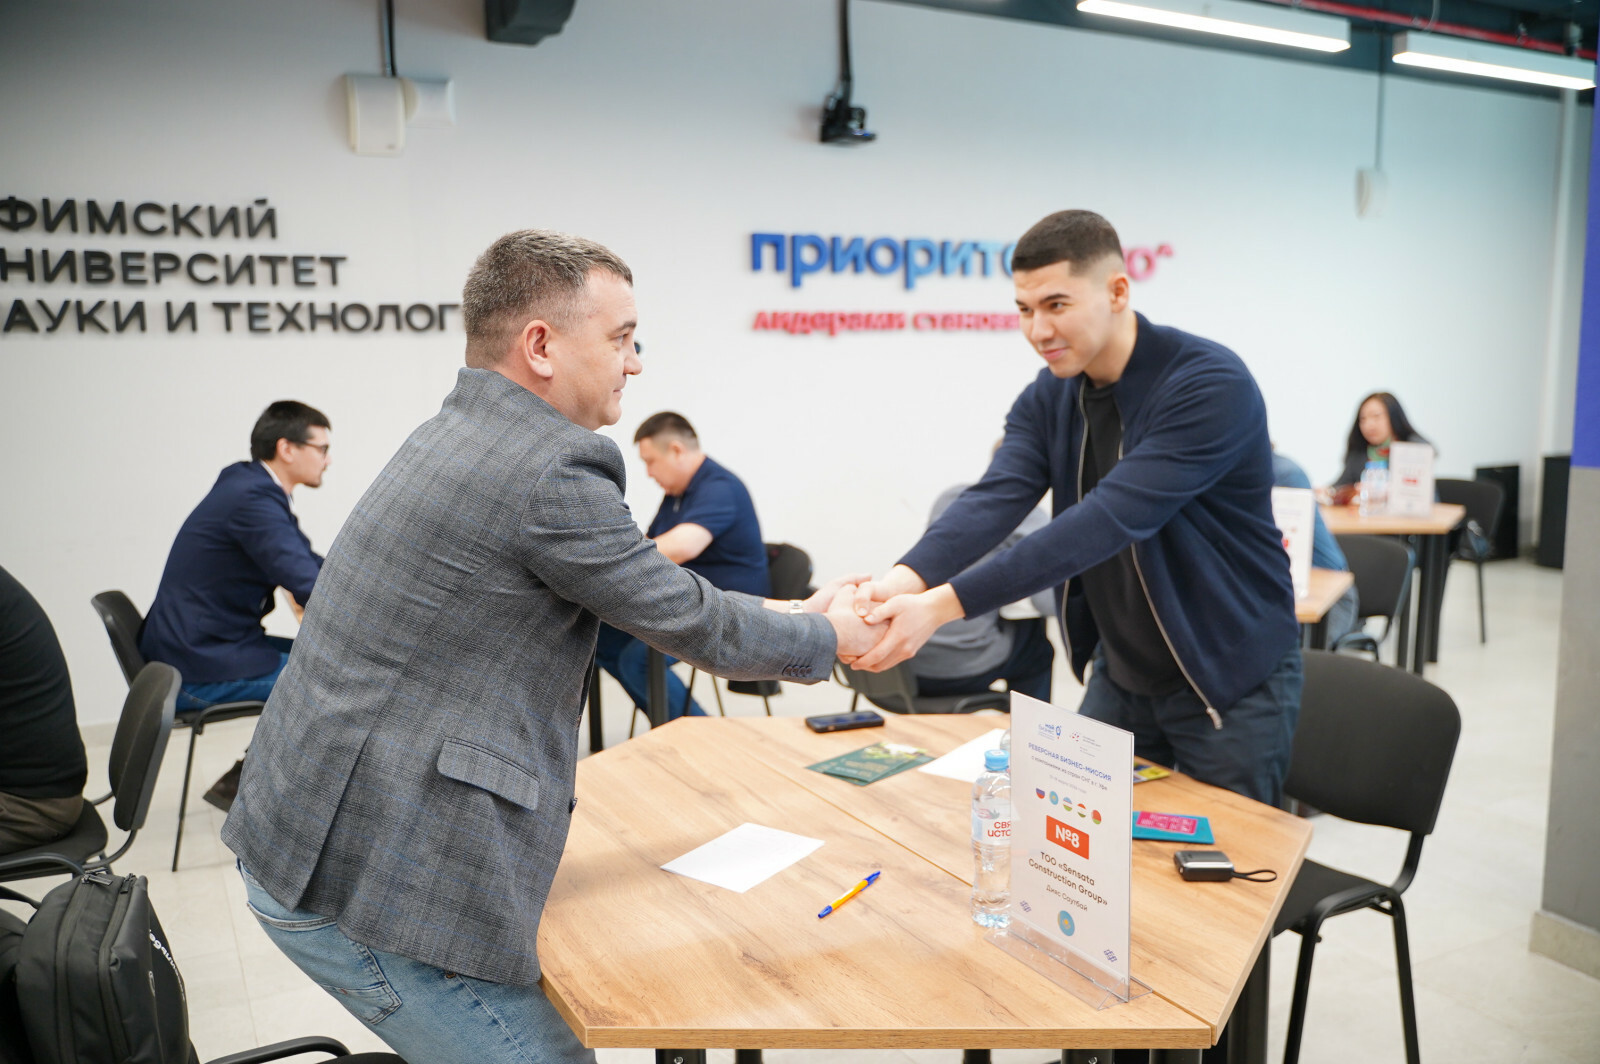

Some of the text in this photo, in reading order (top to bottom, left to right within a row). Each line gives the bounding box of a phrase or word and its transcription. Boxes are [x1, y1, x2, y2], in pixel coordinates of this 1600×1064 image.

[0, 196, 278, 239] ФИМСКИЙ
[0, 248, 347, 286] НИВЕРСИТЕТ
[3, 299, 459, 333] АУКИ И ТЕХНОЛОГ
[1060, 755, 1112, 781] БИЗНЕС-МИССИЯ
[1028, 858, 1108, 906] Construction Group»
[1040, 851, 1095, 886] ТОО «Sensata
